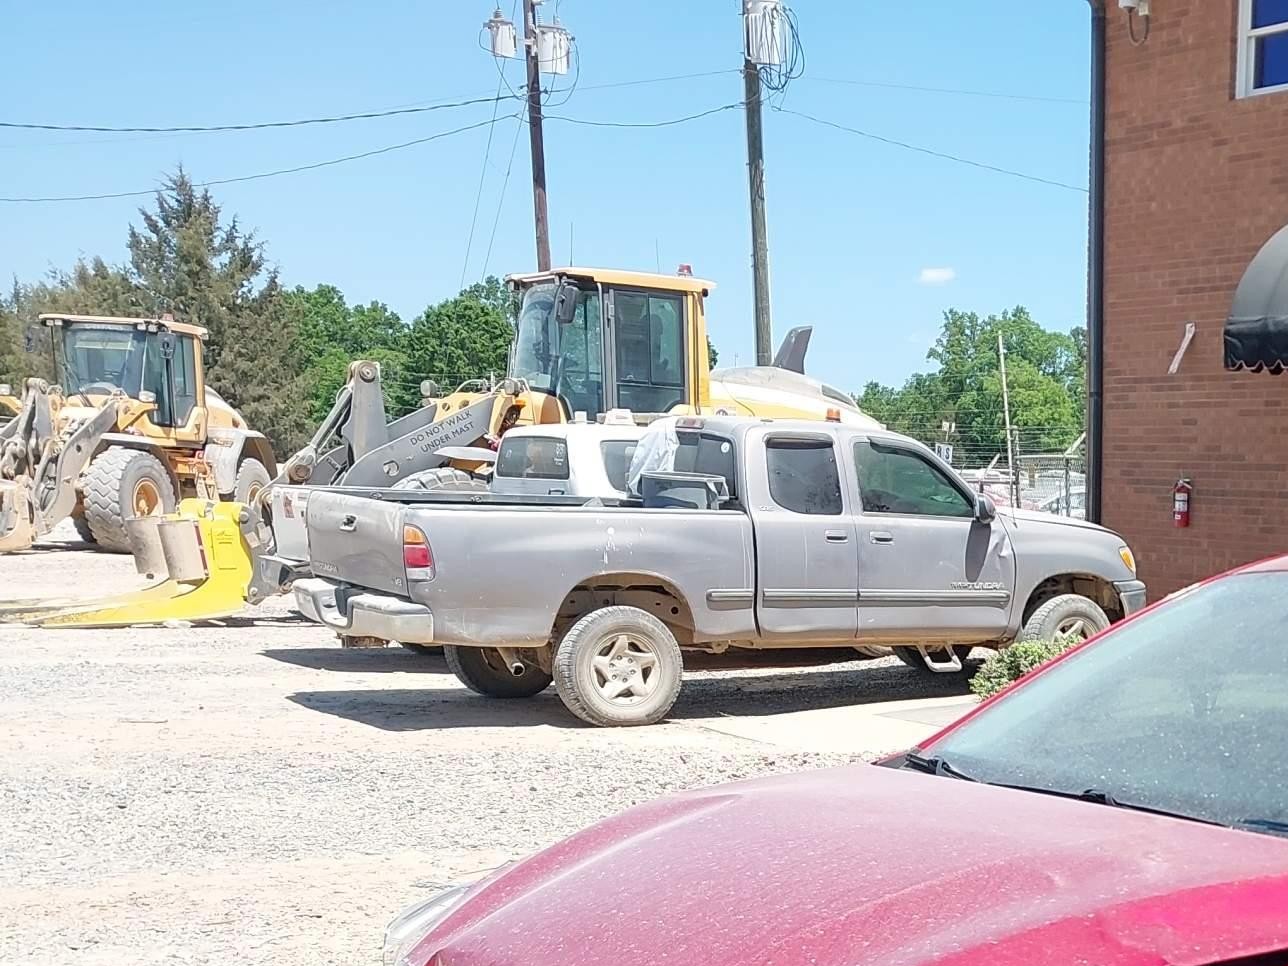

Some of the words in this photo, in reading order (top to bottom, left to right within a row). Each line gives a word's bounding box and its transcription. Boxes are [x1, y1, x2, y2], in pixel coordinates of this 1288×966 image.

[409, 434, 425, 446] DO
[424, 421, 446, 438] NOT
[446, 410, 473, 427] WALK
[421, 433, 452, 453] UNDER
[451, 421, 475, 438] MAST
